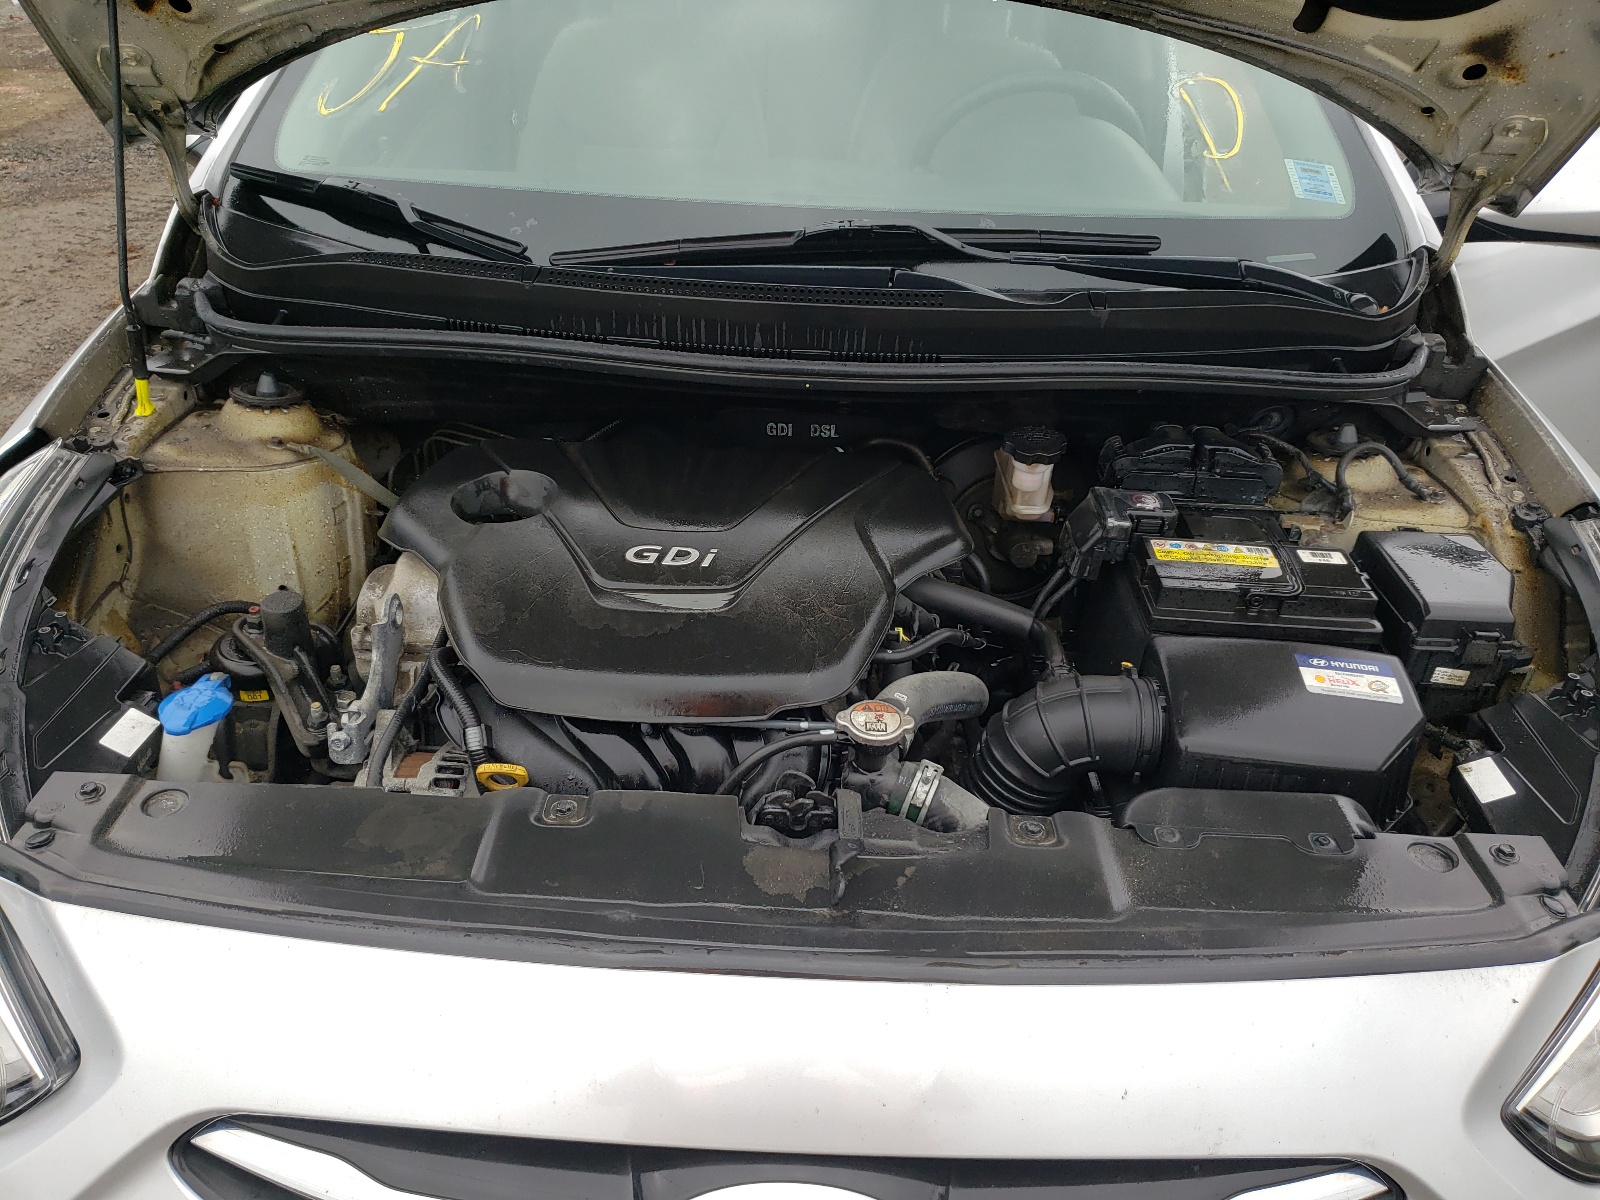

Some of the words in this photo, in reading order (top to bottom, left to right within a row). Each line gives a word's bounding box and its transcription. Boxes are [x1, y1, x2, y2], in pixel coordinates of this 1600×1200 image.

[766, 422, 793, 437] GDI
[810, 424, 839, 438] DSL
[625, 544, 718, 567] GDi
[1330, 660, 1380, 673] HYUNDAI
